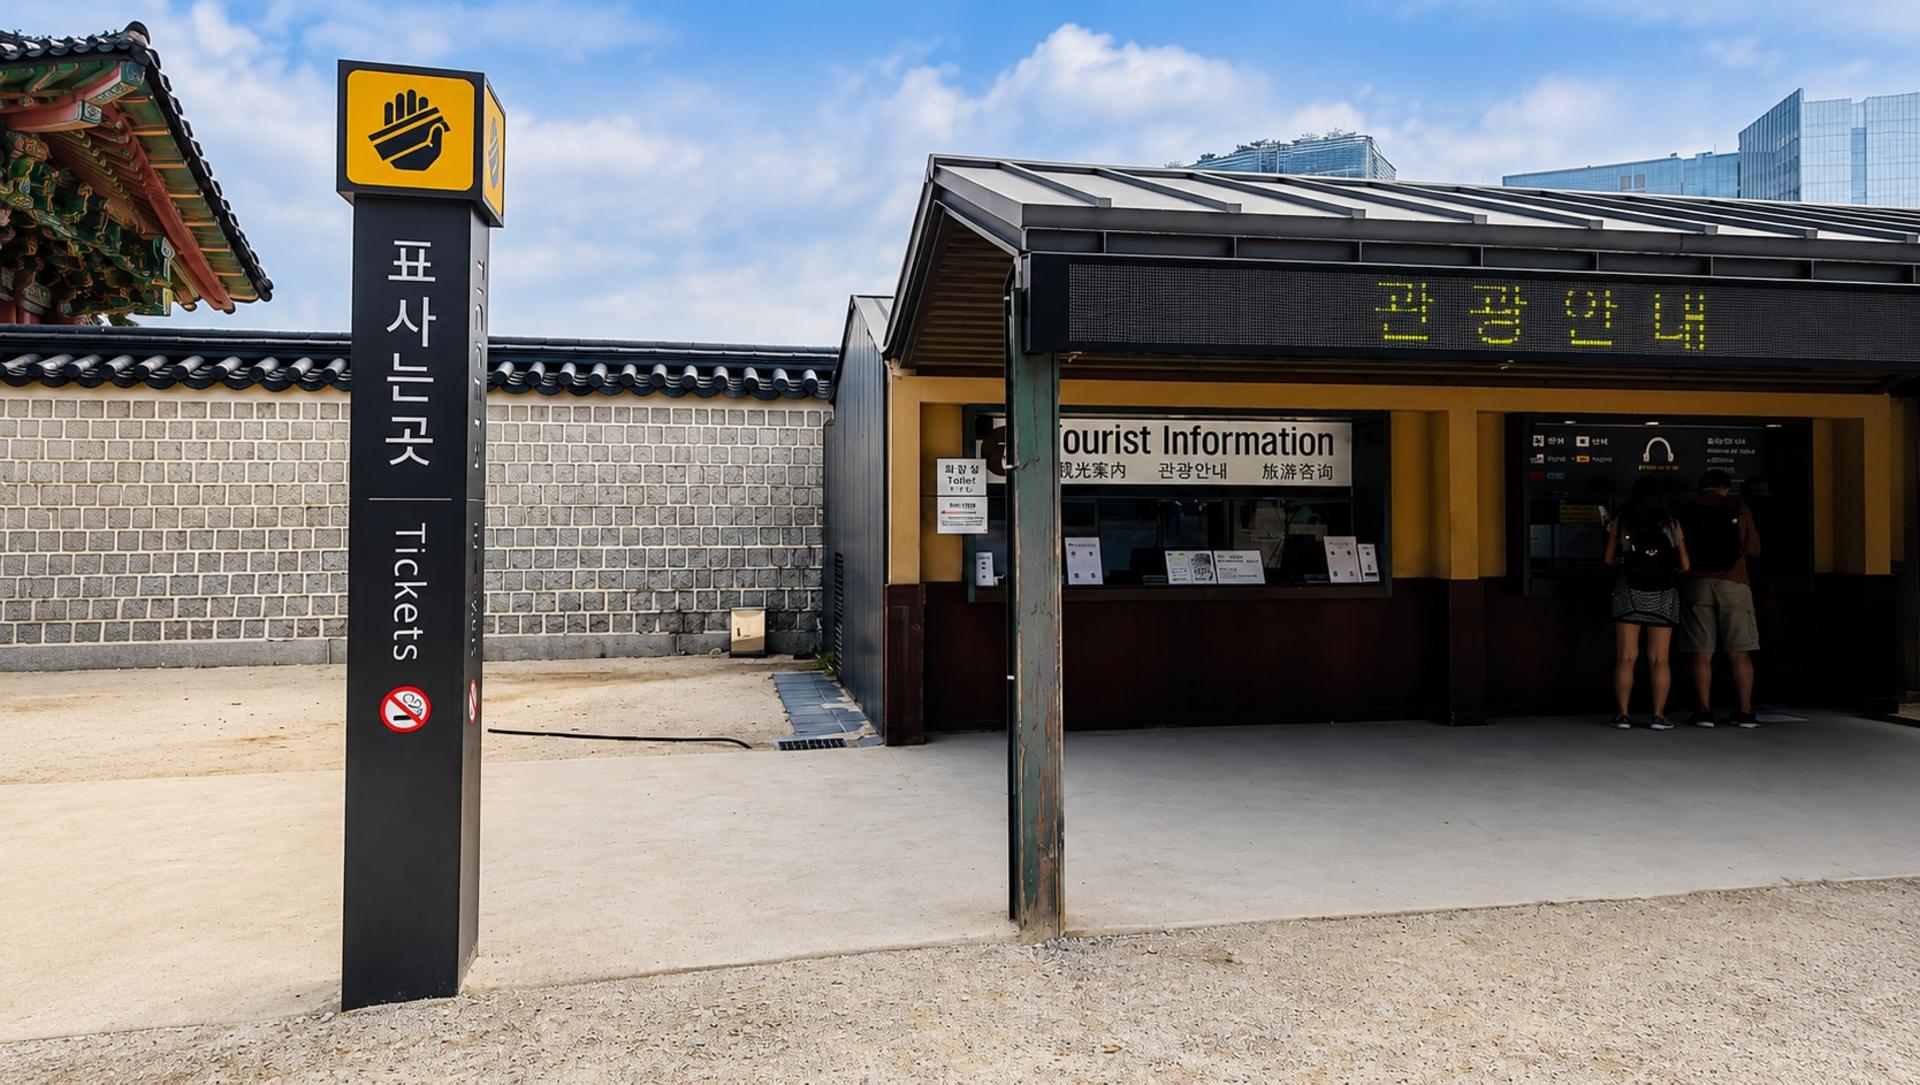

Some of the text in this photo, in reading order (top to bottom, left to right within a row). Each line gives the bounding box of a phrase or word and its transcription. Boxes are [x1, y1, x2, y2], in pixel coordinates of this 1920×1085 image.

[1060, 424, 1334, 456] ourist Information
[1158, 462, 1228, 480] 관광안내
[1262, 463, 1334, 481] 旅游咨询
[947, 476, 976, 485] Toilet
[393, 522, 428, 661] Tickets
